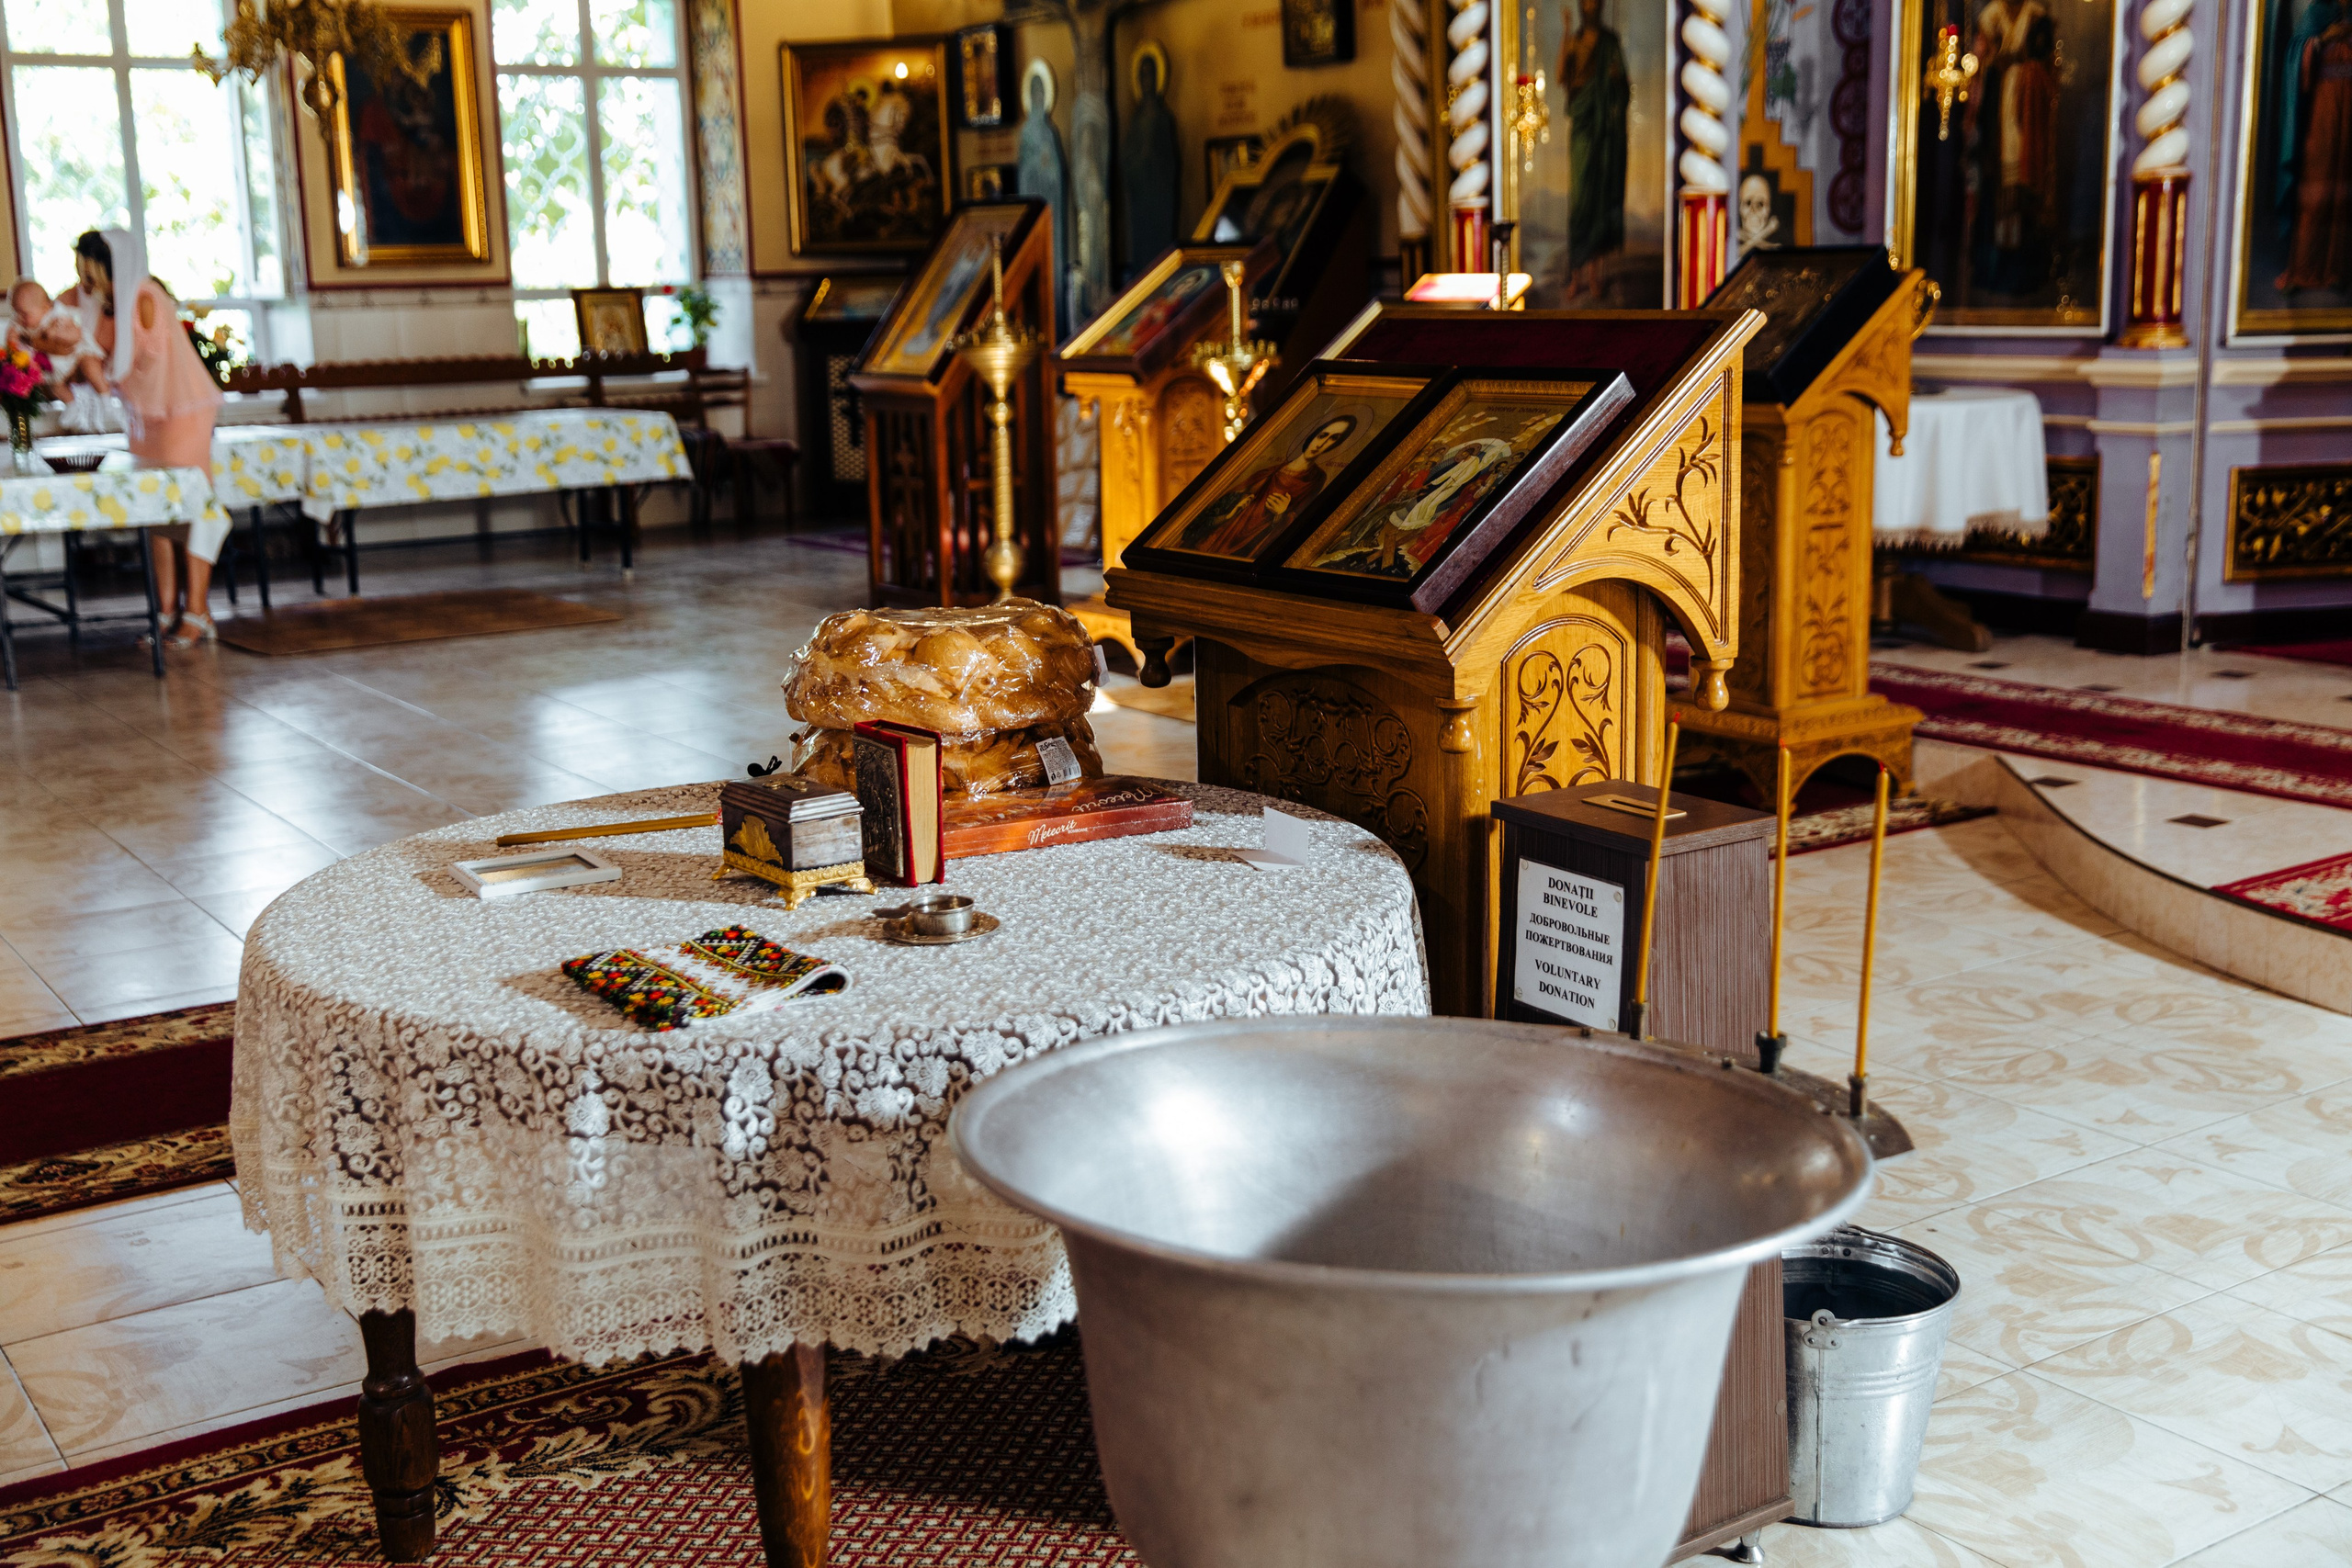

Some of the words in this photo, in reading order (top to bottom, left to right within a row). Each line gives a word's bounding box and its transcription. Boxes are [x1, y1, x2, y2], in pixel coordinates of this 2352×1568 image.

[1028, 819, 1078, 845] Meteorit
[1543, 892, 1598, 919] BINEVOLE
[1529, 912, 1611, 945] ДОБРОВОЛЬНЫЕ
[1525, 930, 1613, 965] ПОЖЕРТВОВАНИЯ
[1534, 959, 1601, 989] VOLUNTARY
[1539, 980, 1595, 1010] DONATION
